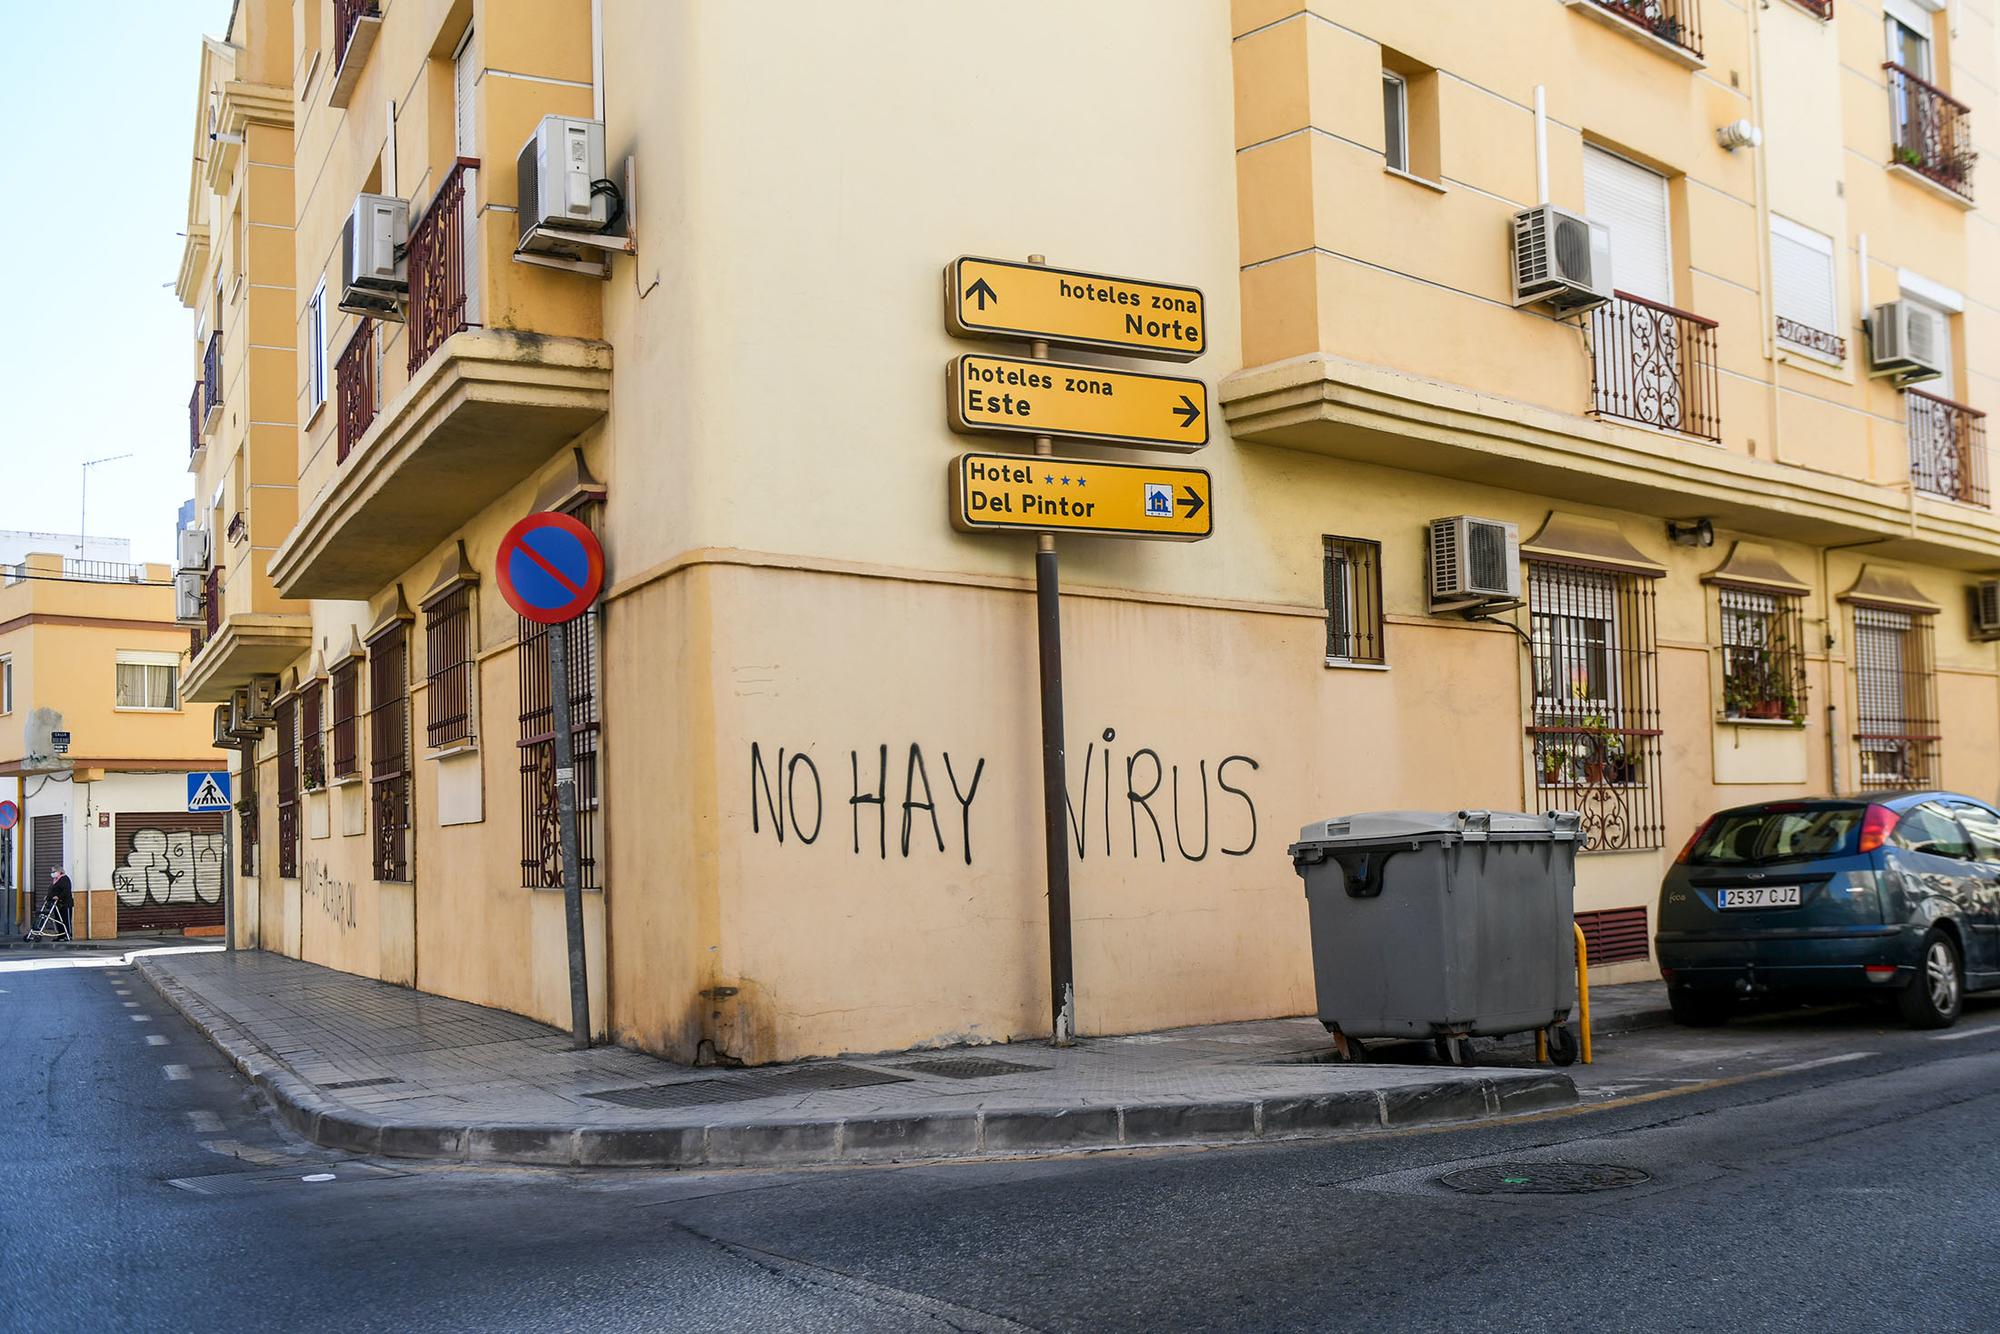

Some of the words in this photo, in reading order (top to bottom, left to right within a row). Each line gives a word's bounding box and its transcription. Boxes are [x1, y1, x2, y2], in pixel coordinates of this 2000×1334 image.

[1059, 279, 1140, 306] hoteles
[1151, 295, 1197, 314] zona
[1125, 313, 1198, 342] Norte
[968, 362, 1053, 389] hoteles
[1065, 377, 1113, 396] zona
[968, 389, 1031, 416] Este
[970, 462, 1033, 484] Hotel
[971, 490, 1012, 513] Del
[1022, 494, 1095, 517] Pintor
[751, 741, 823, 845] NO
[849, 742, 985, 865] HAY
[1727, 889, 1764, 905] 2537
[1769, 888, 1797, 903] CJZ
